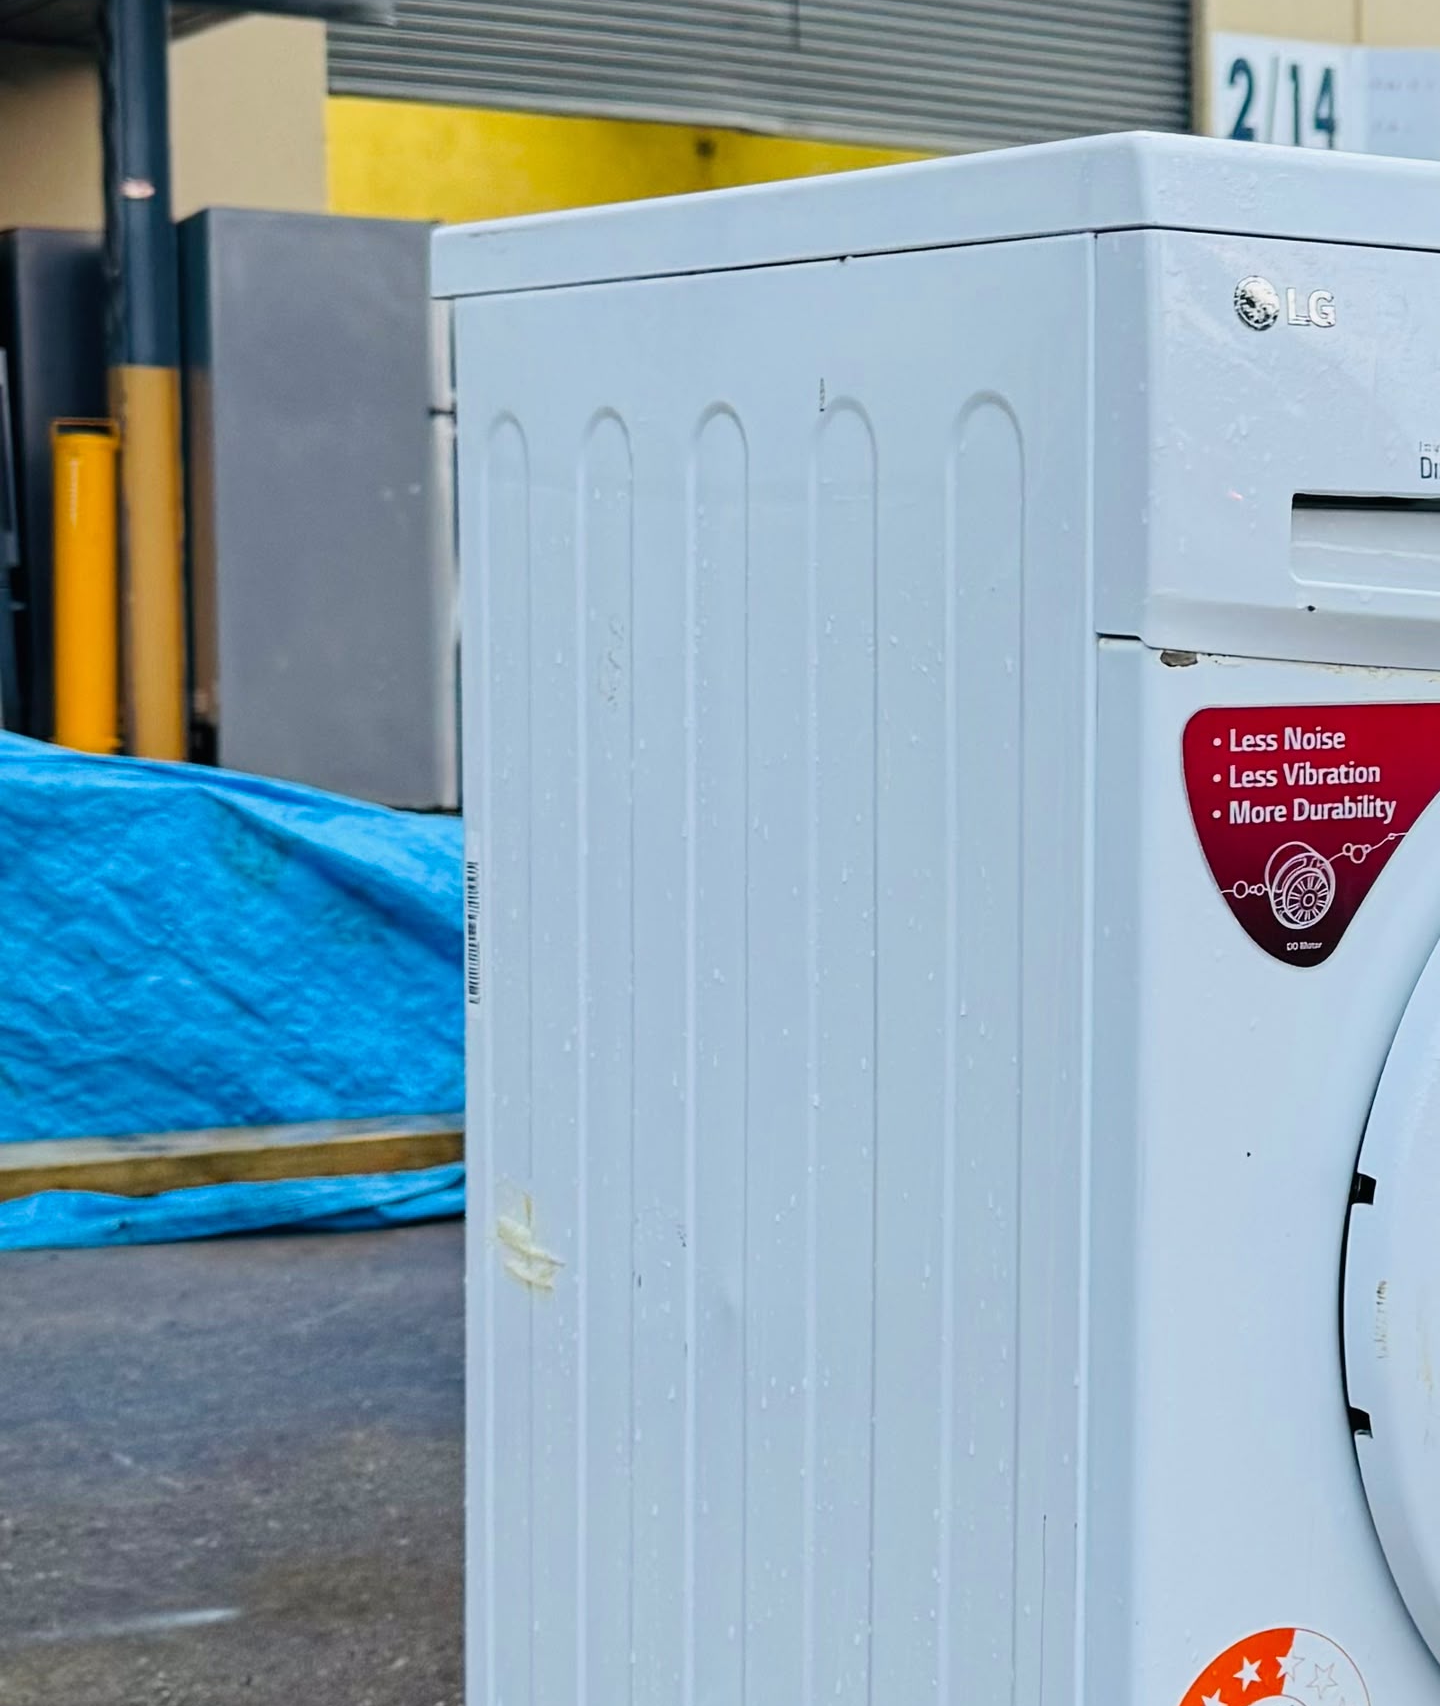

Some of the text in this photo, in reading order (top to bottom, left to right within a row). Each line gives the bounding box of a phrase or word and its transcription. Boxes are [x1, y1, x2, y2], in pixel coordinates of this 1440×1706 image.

[1286, 288, 1336, 328] LG
[1229, 726, 1346, 752] Less Noise
[1229, 761, 1381, 788] Less Vibration
[1229, 795, 1397, 824] More Durability
